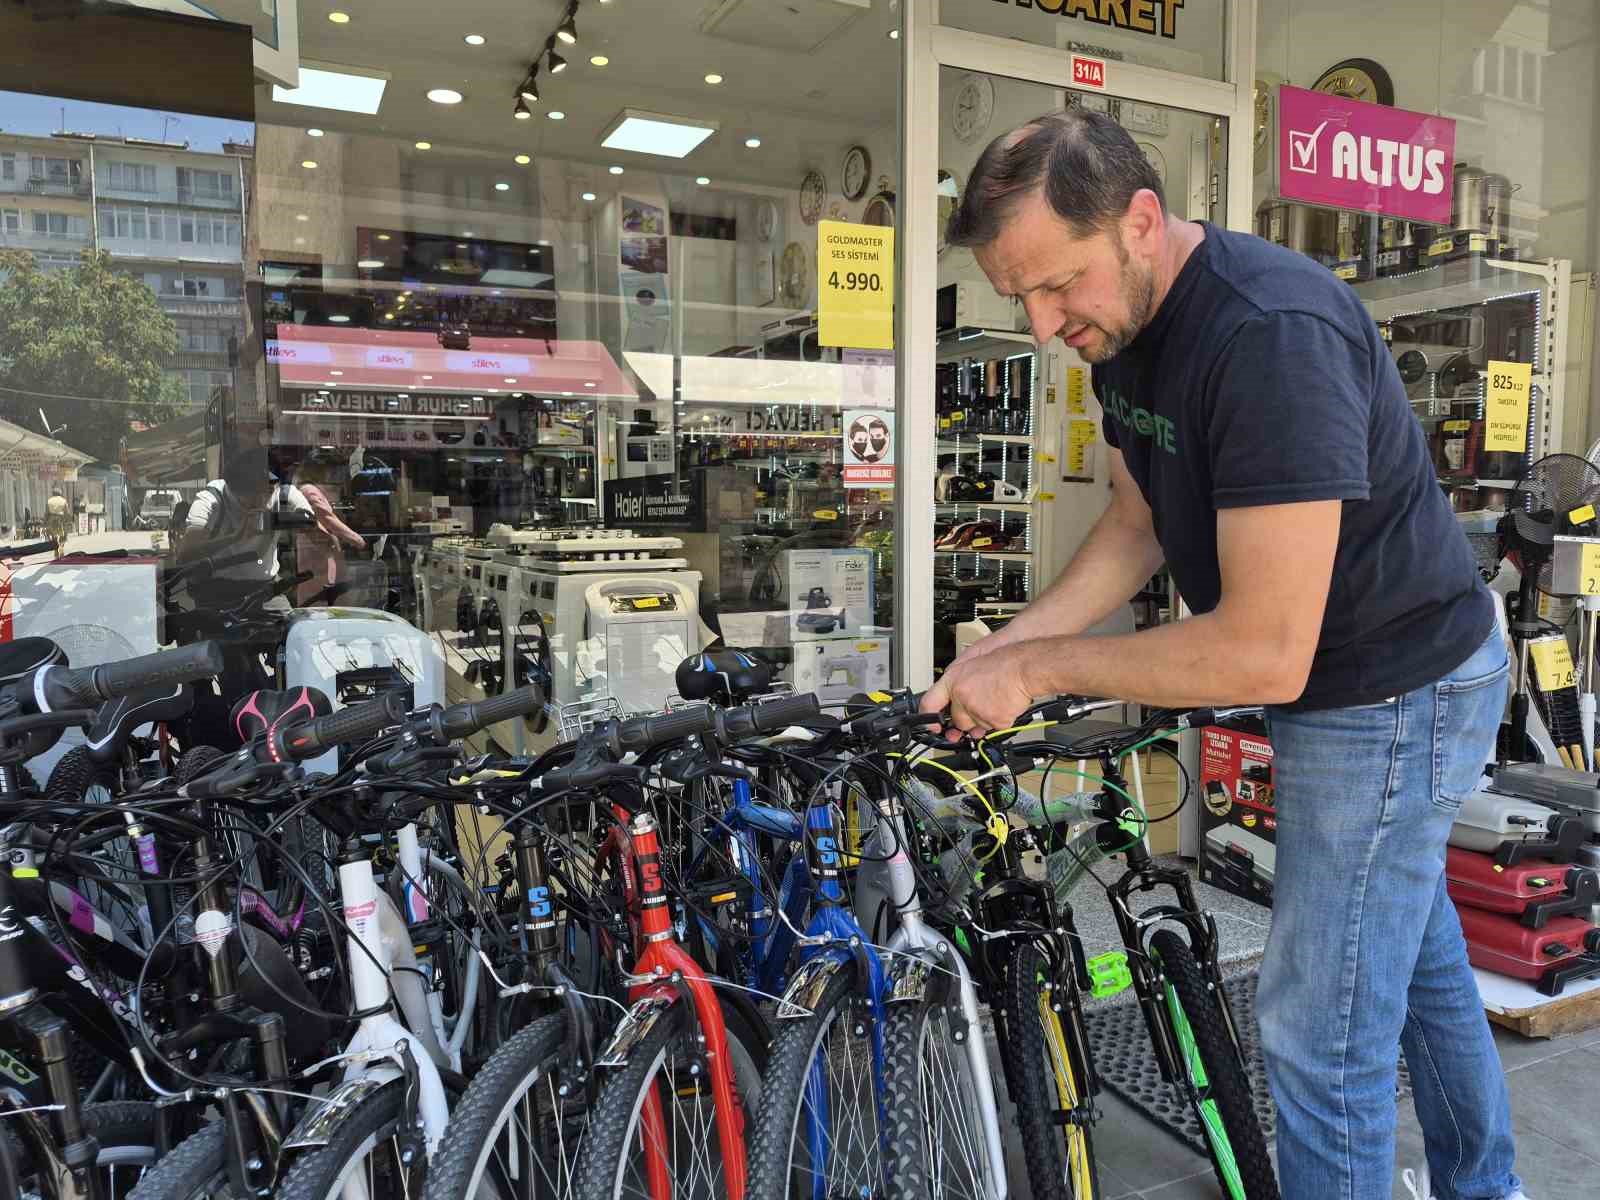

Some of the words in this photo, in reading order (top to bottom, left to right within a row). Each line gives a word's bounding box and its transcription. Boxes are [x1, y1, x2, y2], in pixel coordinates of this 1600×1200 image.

[1075, 62, 1103, 82] 31/A
[1332, 131, 1445, 195] ALTUS
[826, 234, 883, 248] GOLDMASTER
[831, 249, 846, 259] SES
[614, 489, 643, 519] Haier
